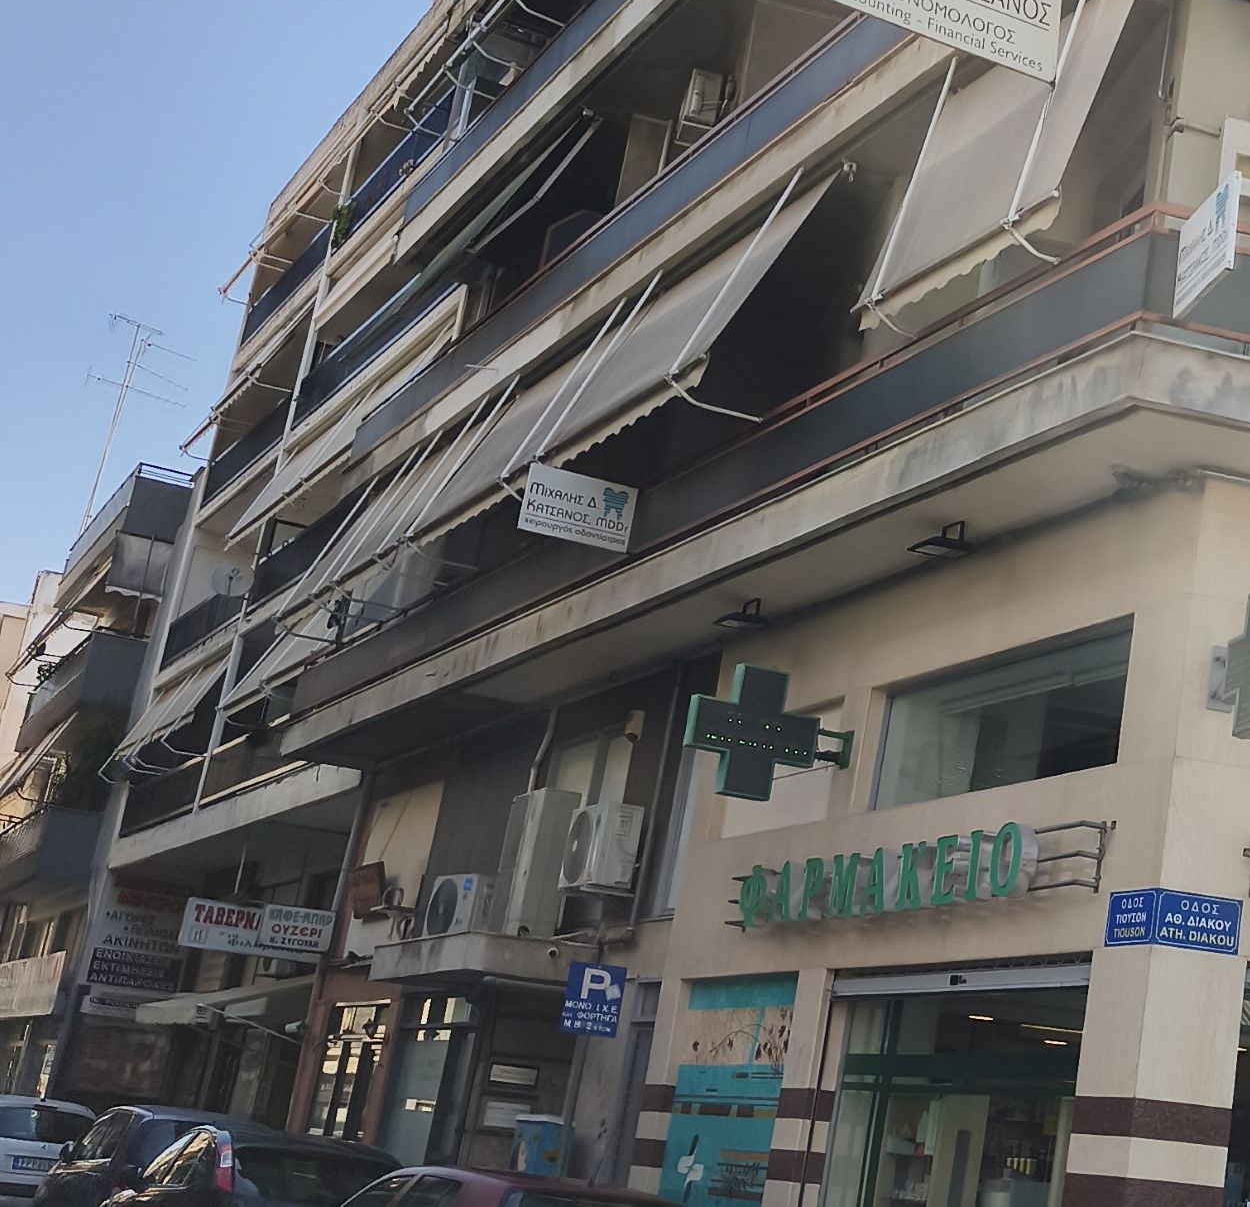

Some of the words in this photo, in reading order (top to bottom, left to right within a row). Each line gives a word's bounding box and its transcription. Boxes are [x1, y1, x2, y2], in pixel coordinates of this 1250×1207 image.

[927, 19, 986, 51] Financial
[989, 41, 1043, 73] Services
[739, 820, 1034, 929] ΦΑΡΜΑΚΕΙΟ
[1121, 897, 1145, 909] ΟΔΟΣ
[1180, 900, 1220, 915] ΟΔΟΣ
[1164, 913, 1186, 926] ΑΘ.
[1187, 916, 1232, 932] ΔΙΑΚΟΥ
[1160, 927, 1187, 940] ATH.
[1189, 931, 1235, 947] DIAKOU
[581, 967, 612, 1000] P
